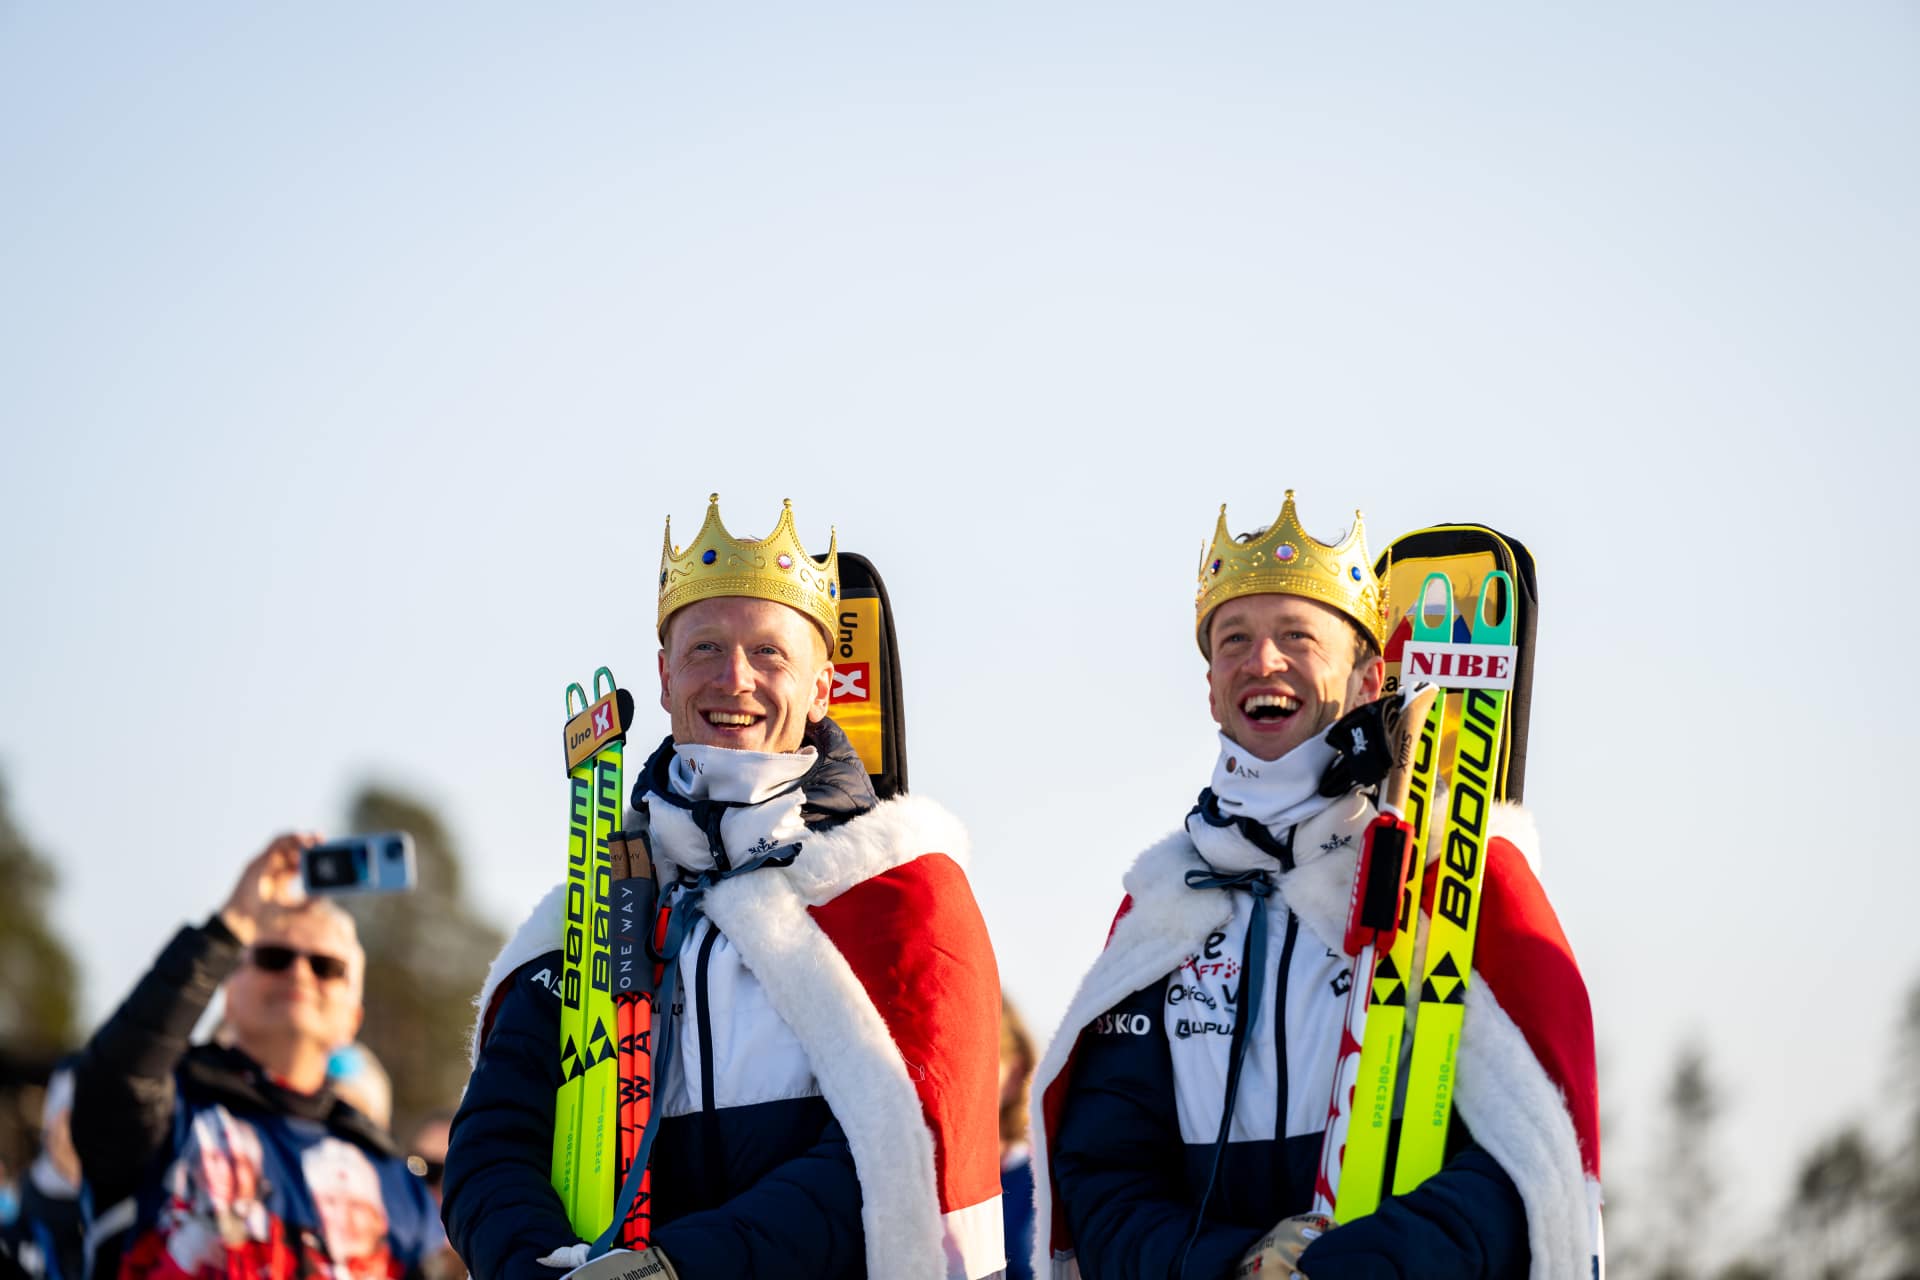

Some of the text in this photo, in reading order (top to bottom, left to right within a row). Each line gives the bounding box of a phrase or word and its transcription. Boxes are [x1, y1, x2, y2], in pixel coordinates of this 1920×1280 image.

[838, 612, 858, 658] Uno
[1408, 652, 1509, 680] NIBE
[570, 728, 591, 749] Uno
